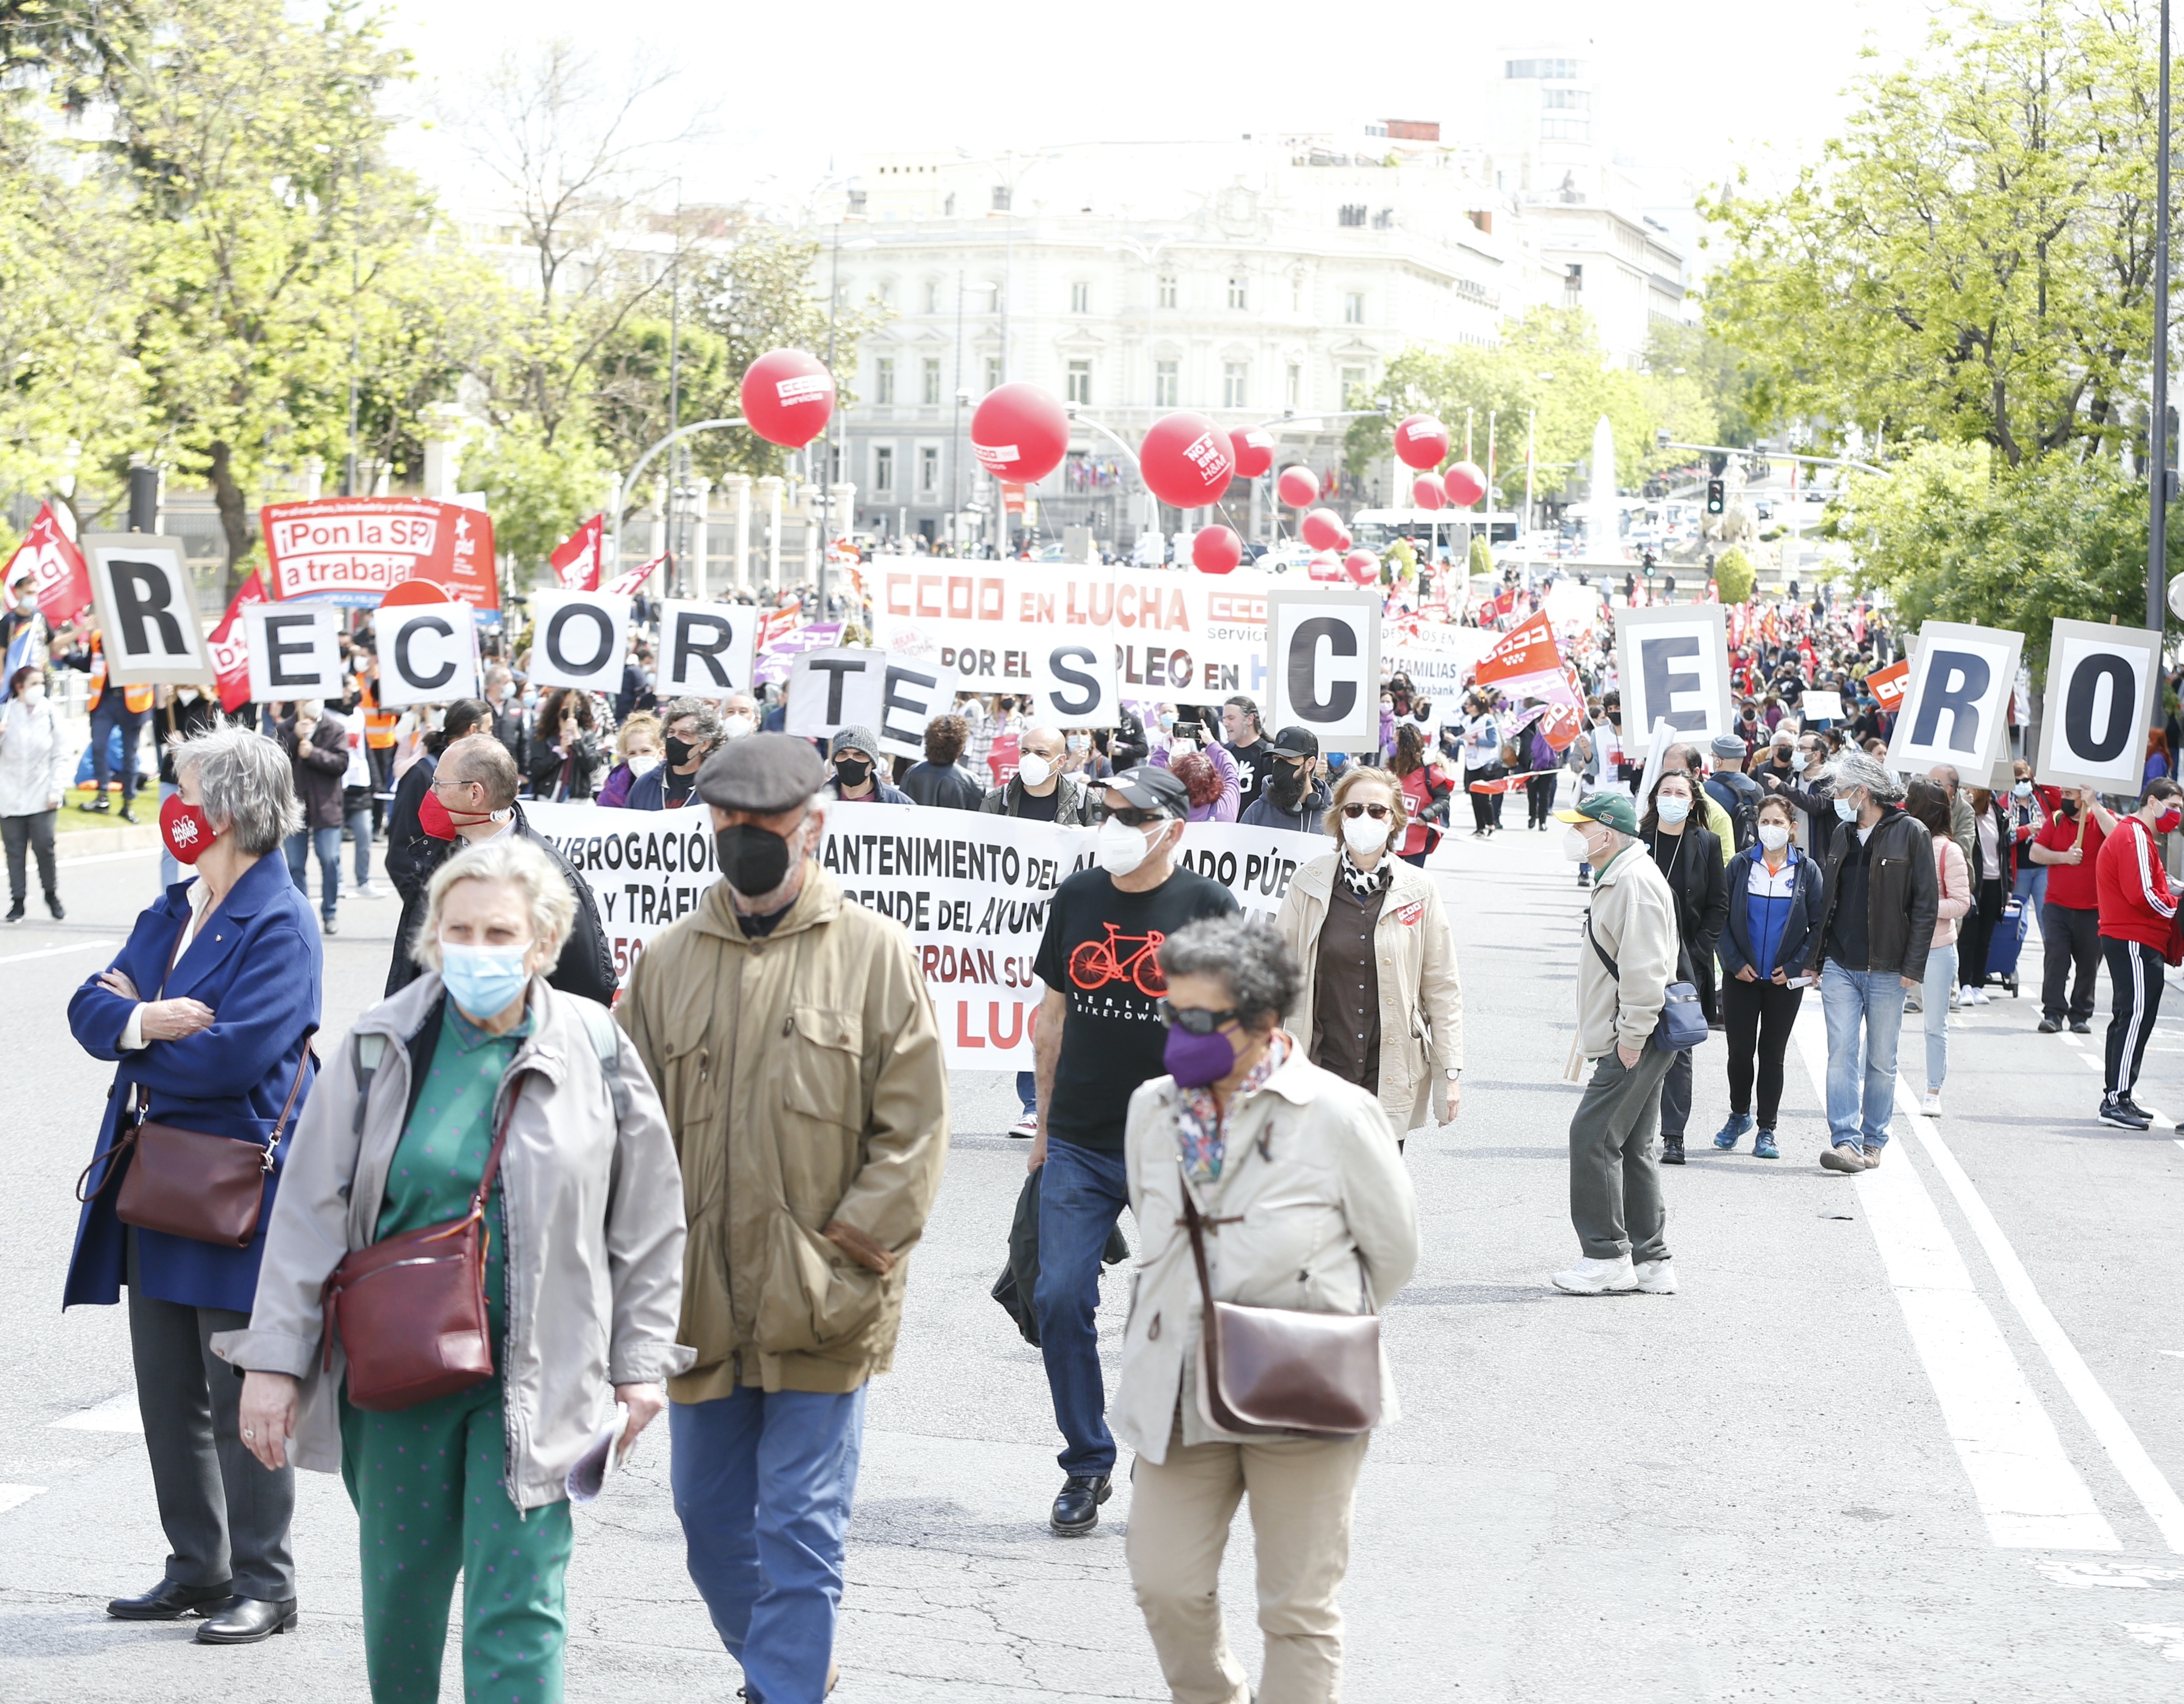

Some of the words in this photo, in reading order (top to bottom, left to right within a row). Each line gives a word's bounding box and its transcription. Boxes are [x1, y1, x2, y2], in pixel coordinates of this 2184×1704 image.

[1187, 444, 1205, 462] NO
[1197, 446, 1219, 468] ERE
[1201, 454, 1226, 481] H&M
[282, 523, 350, 553] ¡Pon
[359, 520, 382, 544] la
[108, 560, 189, 655] R
[287, 568, 299, 587] a
[886, 573, 1004, 621] CCOO
[1020, 592, 1055, 623] EN
[1066, 581, 1190, 632] LUCHA
[265, 614, 320, 686] E
[395, 616, 456, 689] C
[547, 603, 614, 676] O
[672, 612, 732, 688] R
[941, 647, 995, 676] POR
[1004, 650, 1032, 678] EL
[1205, 663, 1239, 690] EN
[1288, 617, 1357, 723] C
[1399, 659, 1457, 679] FAMILIAS
[809, 659, 866, 725] T
[882, 665, 937, 746] E
[1049, 645, 1101, 715] S
[1641, 636, 1707, 733] E
[1911, 650, 1990, 754] R
[815, 834, 1020, 886] ANTENIMIENTO
[1026, 857, 1062, 891] DEL
[1244, 846, 1305, 899] PÚB
[604, 893, 617, 922] Y
[938, 900, 973, 933] DEL
[1077, 1004, 1162, 1023] BIKETOWN
